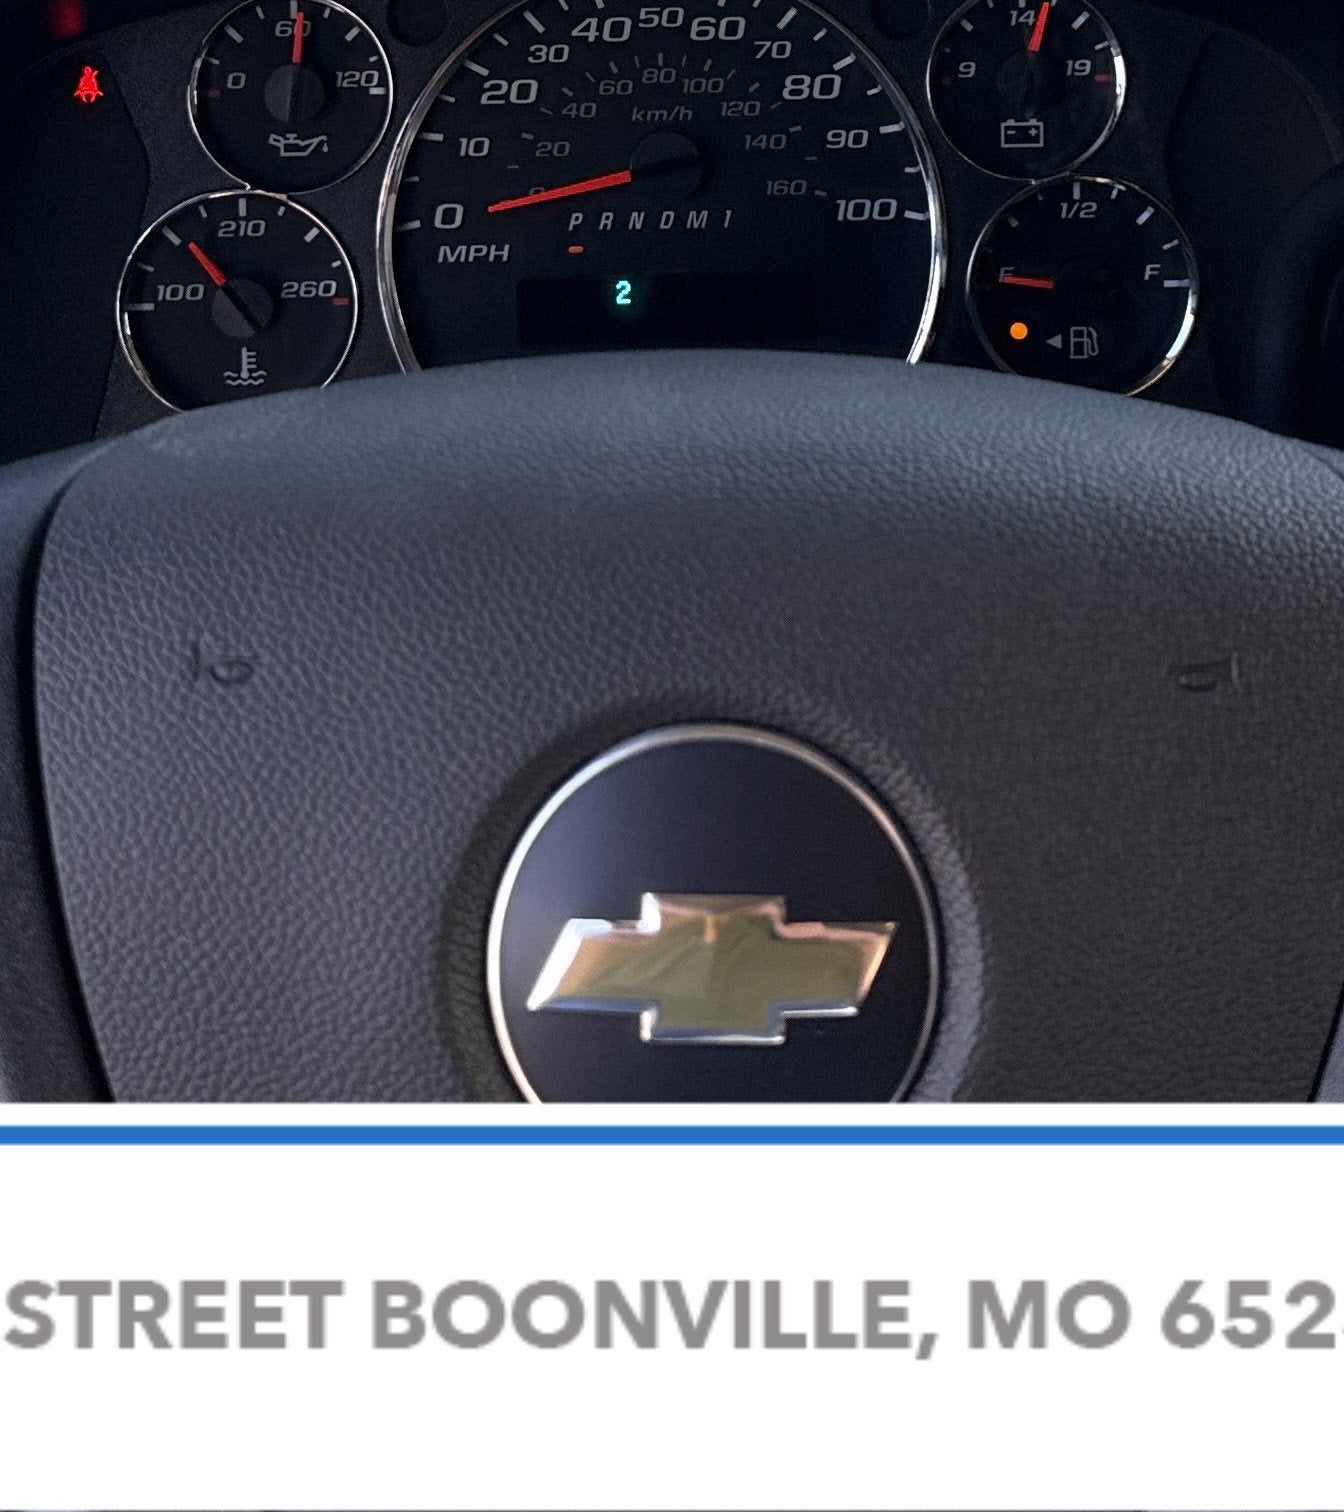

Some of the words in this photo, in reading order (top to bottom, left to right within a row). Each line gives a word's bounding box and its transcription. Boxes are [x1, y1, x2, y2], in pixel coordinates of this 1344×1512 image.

[638, 7, 684, 28] 50
[1010, 10, 1036, 26] 14
[571, 17, 632, 42] 40
[690, 16, 746, 40] 60
[528, 44, 569, 64] 30
[754, 40, 792, 59] 70
[958, 61, 976, 78] 9
[1066, 59, 1092, 75] 19
[227, 72, 246, 89] 0
[337, 70, 379, 87] 120
[641, 68, 677, 84] 80
[480, 79, 538, 104] 20
[599, 79, 634, 95] 60
[682, 77, 725, 93] 100
[783, 74, 842, 100] 80
[562, 102, 597, 118] 40
[632, 105, 693, 121] km/h
[721, 100, 761, 117] 120
[459, 137, 490, 157] 10
[745, 133, 787, 150] 140
[826, 129, 869, 148] 90
[535, 141, 570, 157] 20
[766, 179, 807, 196] 160
[434, 203, 464, 229] 0
[836, 199, 897, 221] 100
[1060, 202, 1097, 219] 1/2
[218, 220, 266, 237] 210
[437, 244, 510, 263] MPH
[1144, 264, 1161, 281] F
[157, 284, 205, 301] 100
[281, 280, 338, 299] 260
[615, 280, 632, 305] 2
